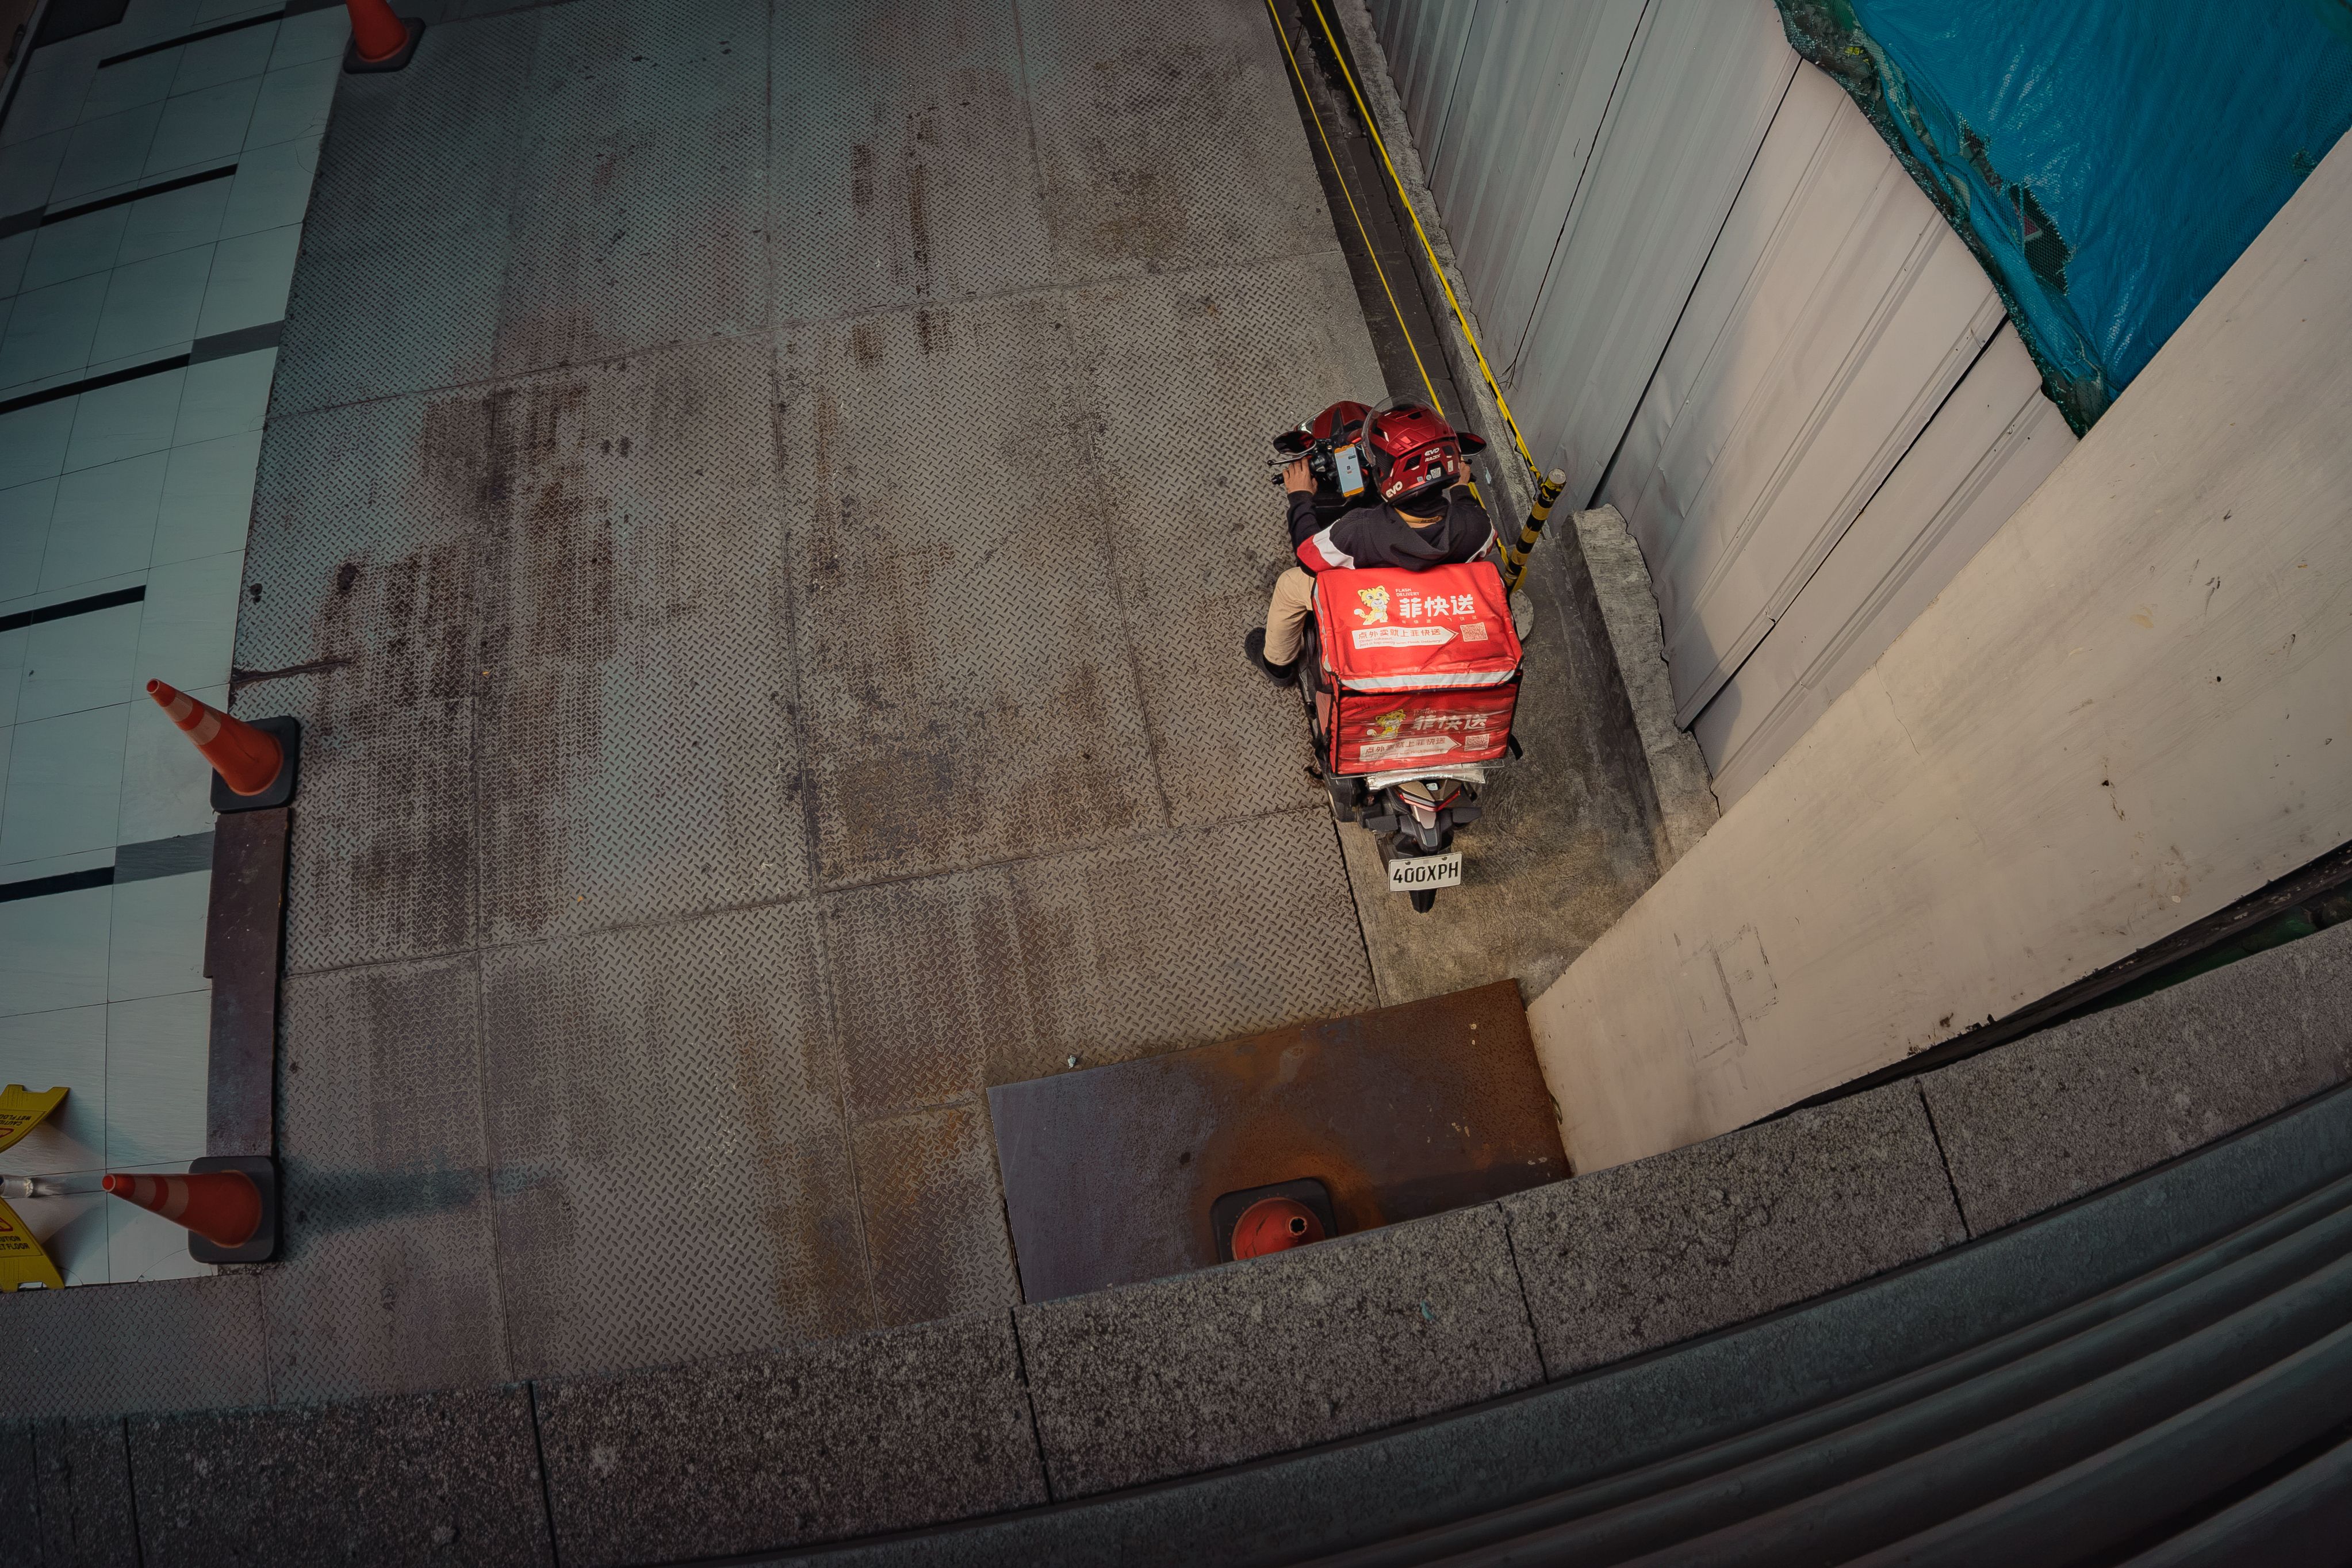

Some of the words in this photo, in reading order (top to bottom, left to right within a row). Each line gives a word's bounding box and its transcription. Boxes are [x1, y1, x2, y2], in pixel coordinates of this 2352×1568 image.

[1424, 448, 1439, 456] EVO
[1386, 481, 1403, 498] EVO
[1399, 594, 1475, 618] 菲快送
[1393, 861, 1459, 883] 400XPH
